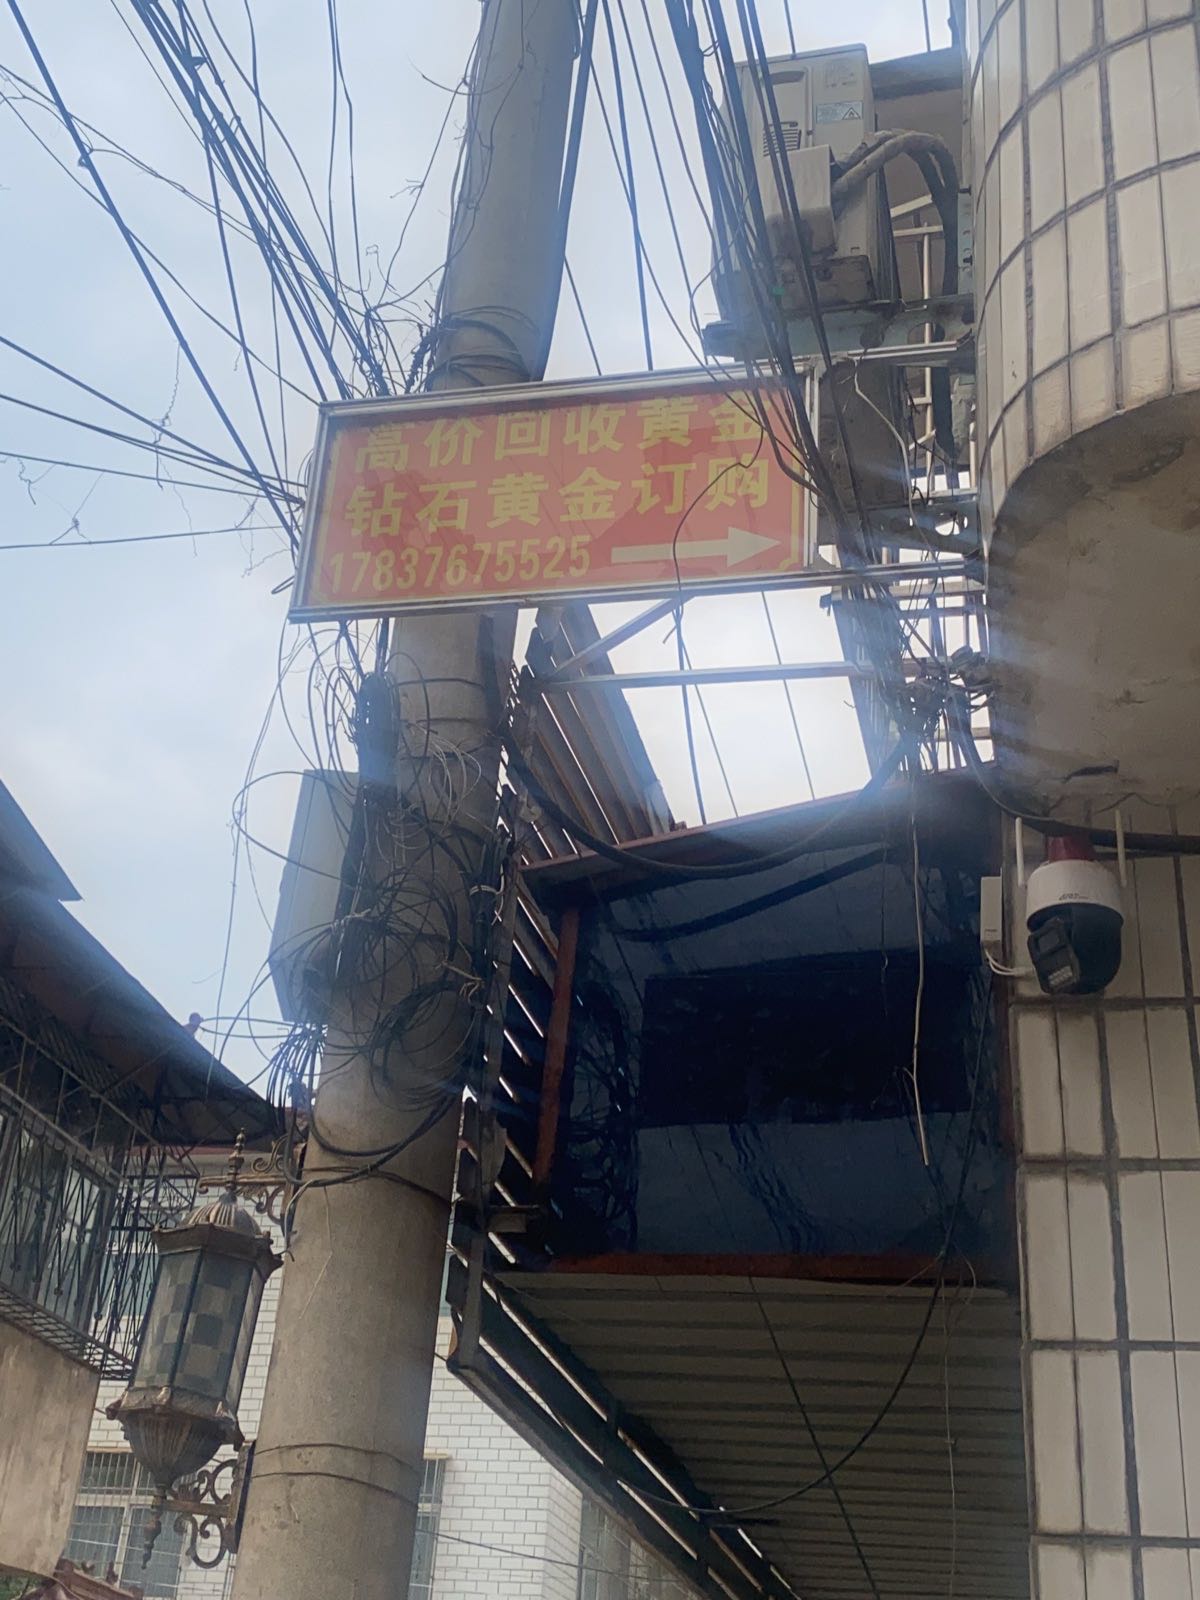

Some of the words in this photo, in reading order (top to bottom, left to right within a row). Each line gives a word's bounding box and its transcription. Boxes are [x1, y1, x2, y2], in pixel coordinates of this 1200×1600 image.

[355, 388, 772, 473] 高价回收黄金
[345, 452, 769, 537] 钻石黄金订购
[330, 535, 592, 593] 17837675525
